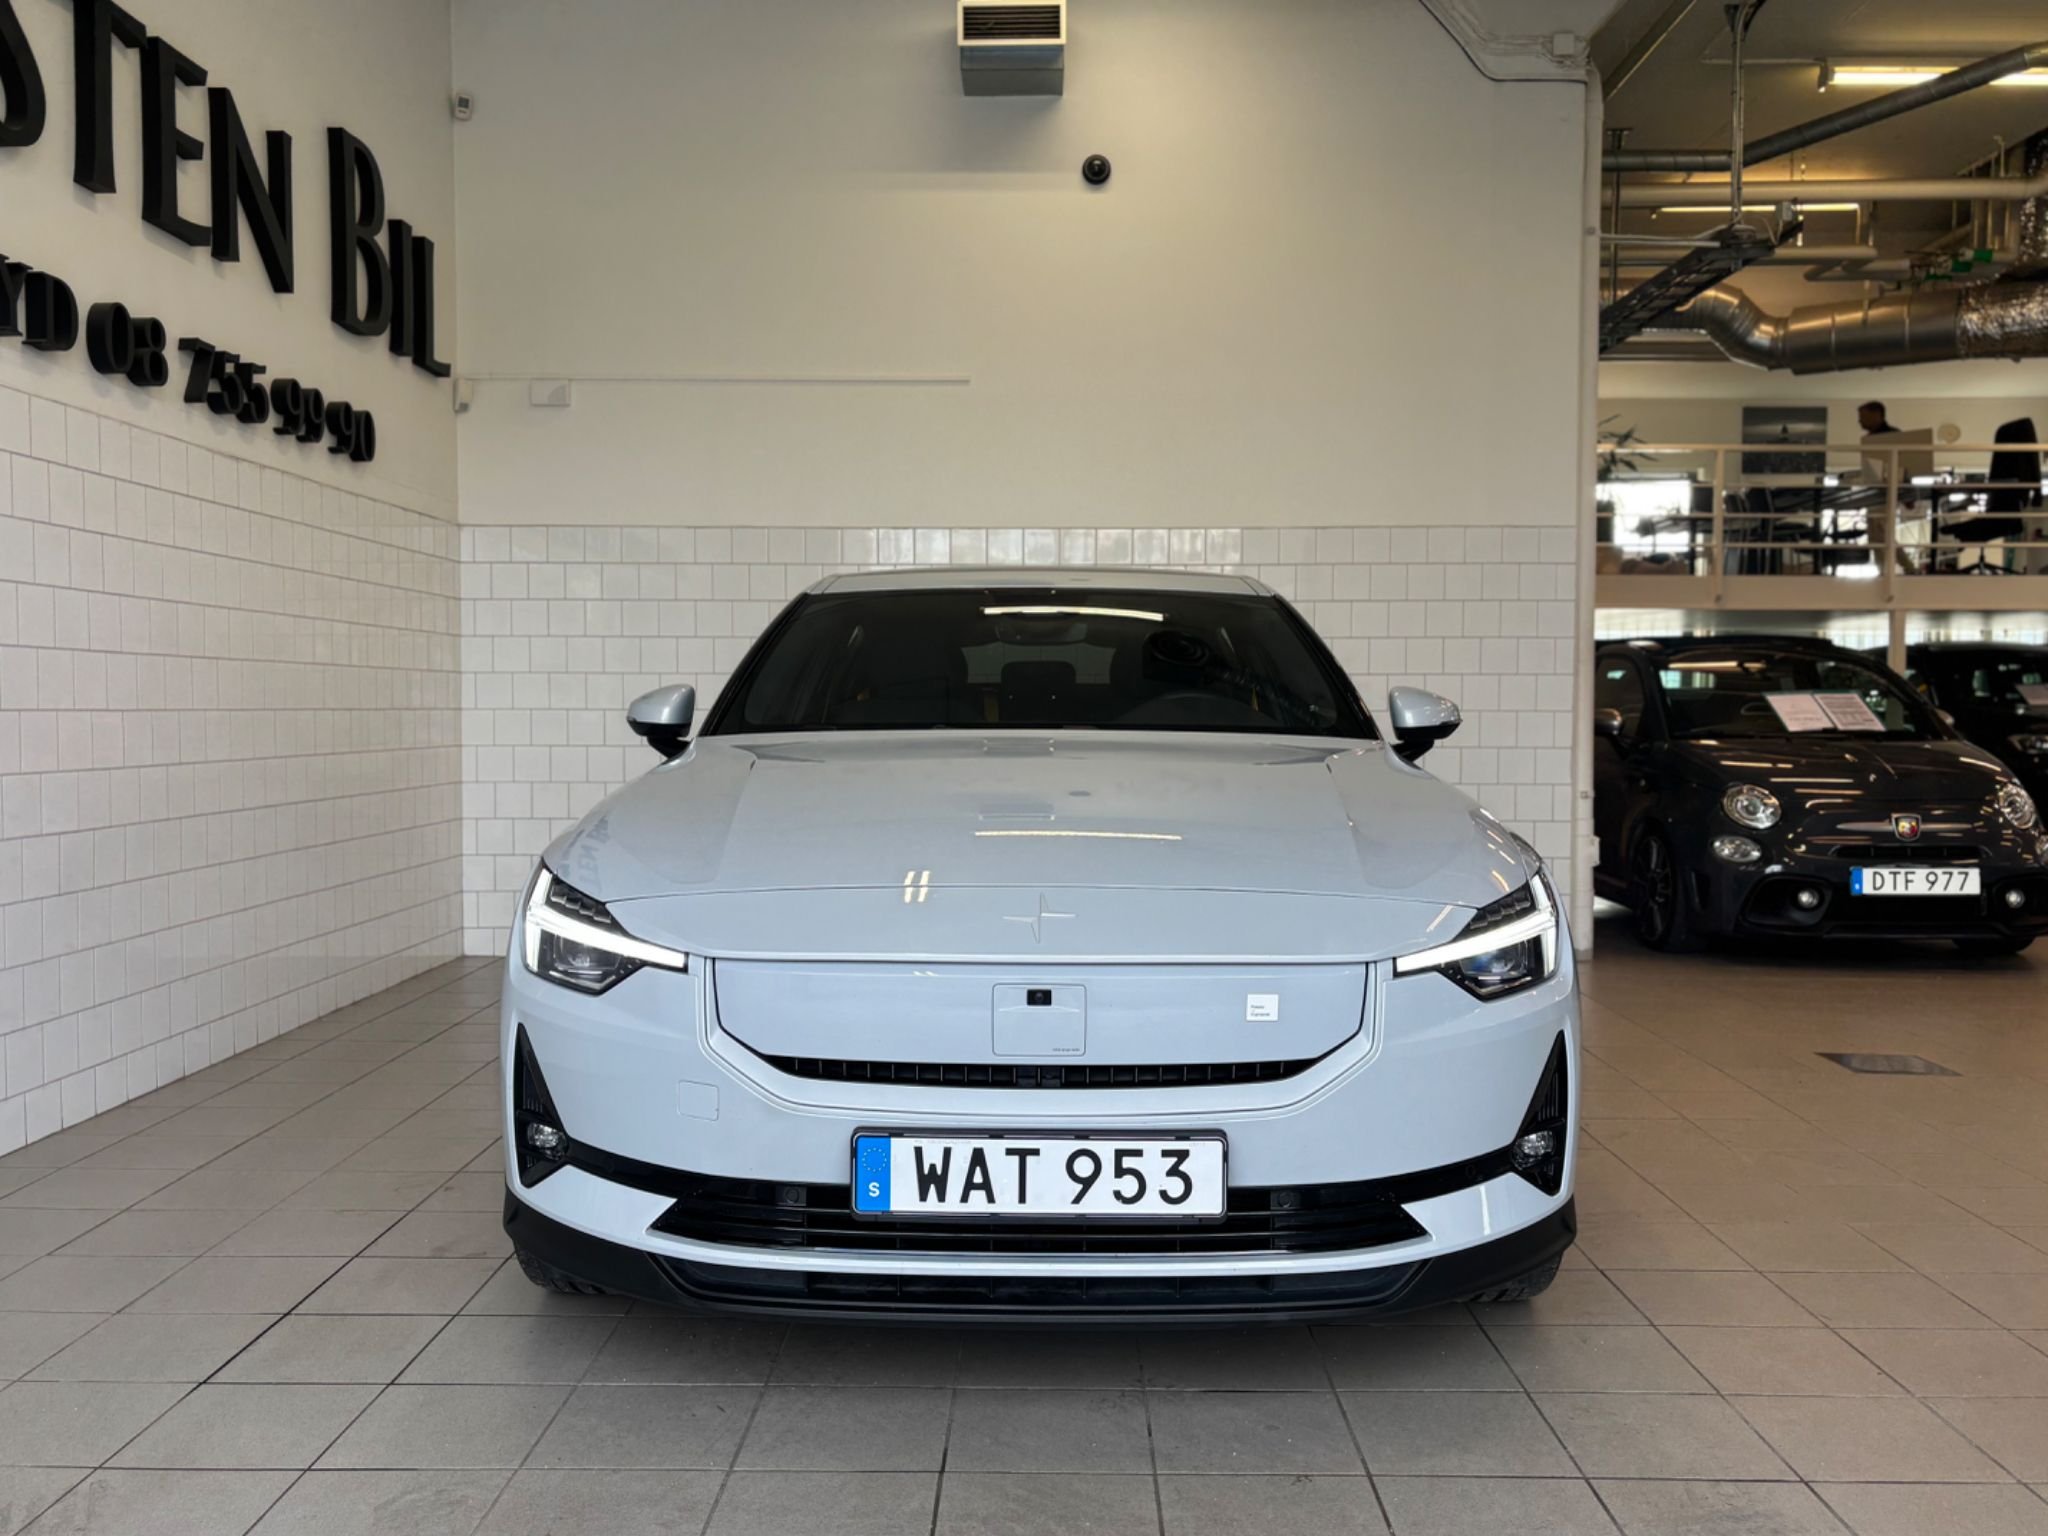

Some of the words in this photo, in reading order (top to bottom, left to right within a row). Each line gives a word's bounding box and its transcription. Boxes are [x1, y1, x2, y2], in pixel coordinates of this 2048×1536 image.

[327, 127, 451, 378] BIL
[86, 302, 168, 386] 08
[178, 337, 269, 423] 755
[270, 378, 325, 443] 99
[325, 401, 376, 462] 90
[1872, 871, 1916, 891] DTF
[1925, 871, 1970, 891] 977
[868, 1182, 880, 1197] S
[914, 1146, 1040, 1205] WAT
[1065, 1148, 1193, 1205] 953
